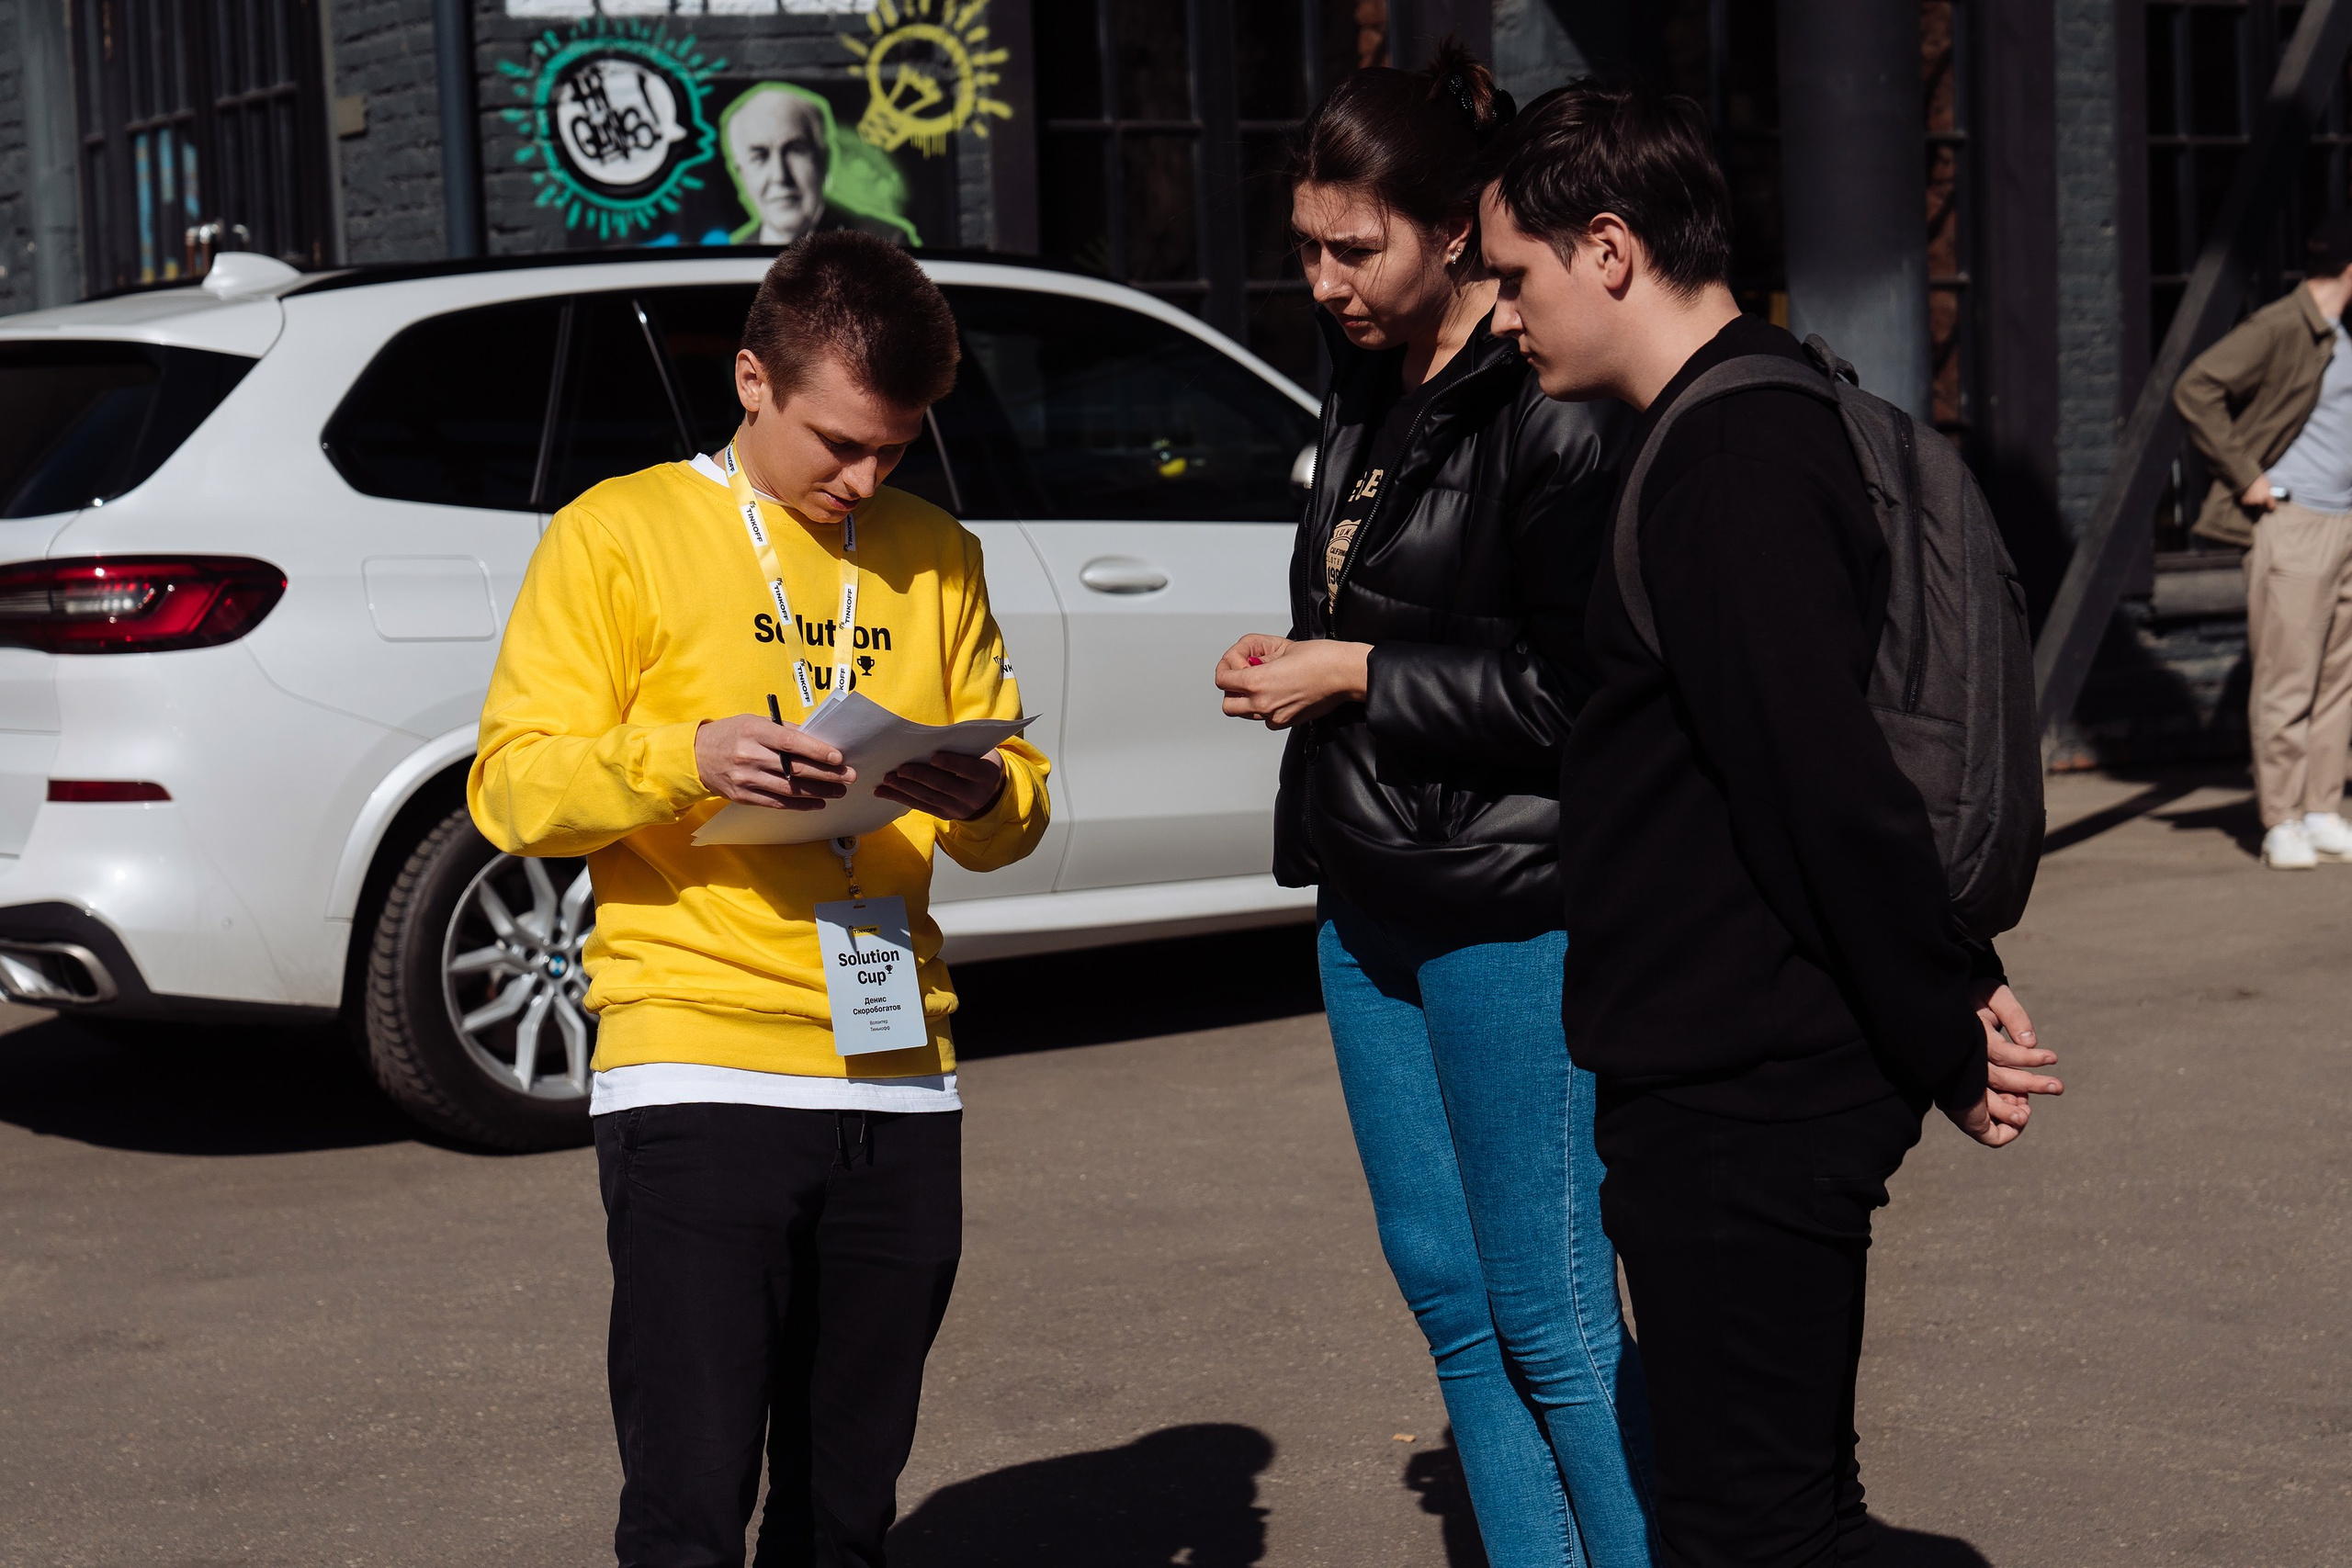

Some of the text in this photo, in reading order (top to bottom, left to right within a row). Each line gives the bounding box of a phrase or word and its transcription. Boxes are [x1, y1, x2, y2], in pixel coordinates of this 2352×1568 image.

[746, 508, 763, 543] TINKOFF
[774, 585, 789, 622] TINKOFF
[844, 588, 853, 625] TINKOFF
[753, 613, 892, 651] Sluton
[797, 666, 811, 704] TINKOFF
[838, 949, 899, 966] Solution
[857, 970, 887, 986] Cup
[853, 1005, 901, 1015] Скоробогатов
[865, 997, 888, 1005] Денис
